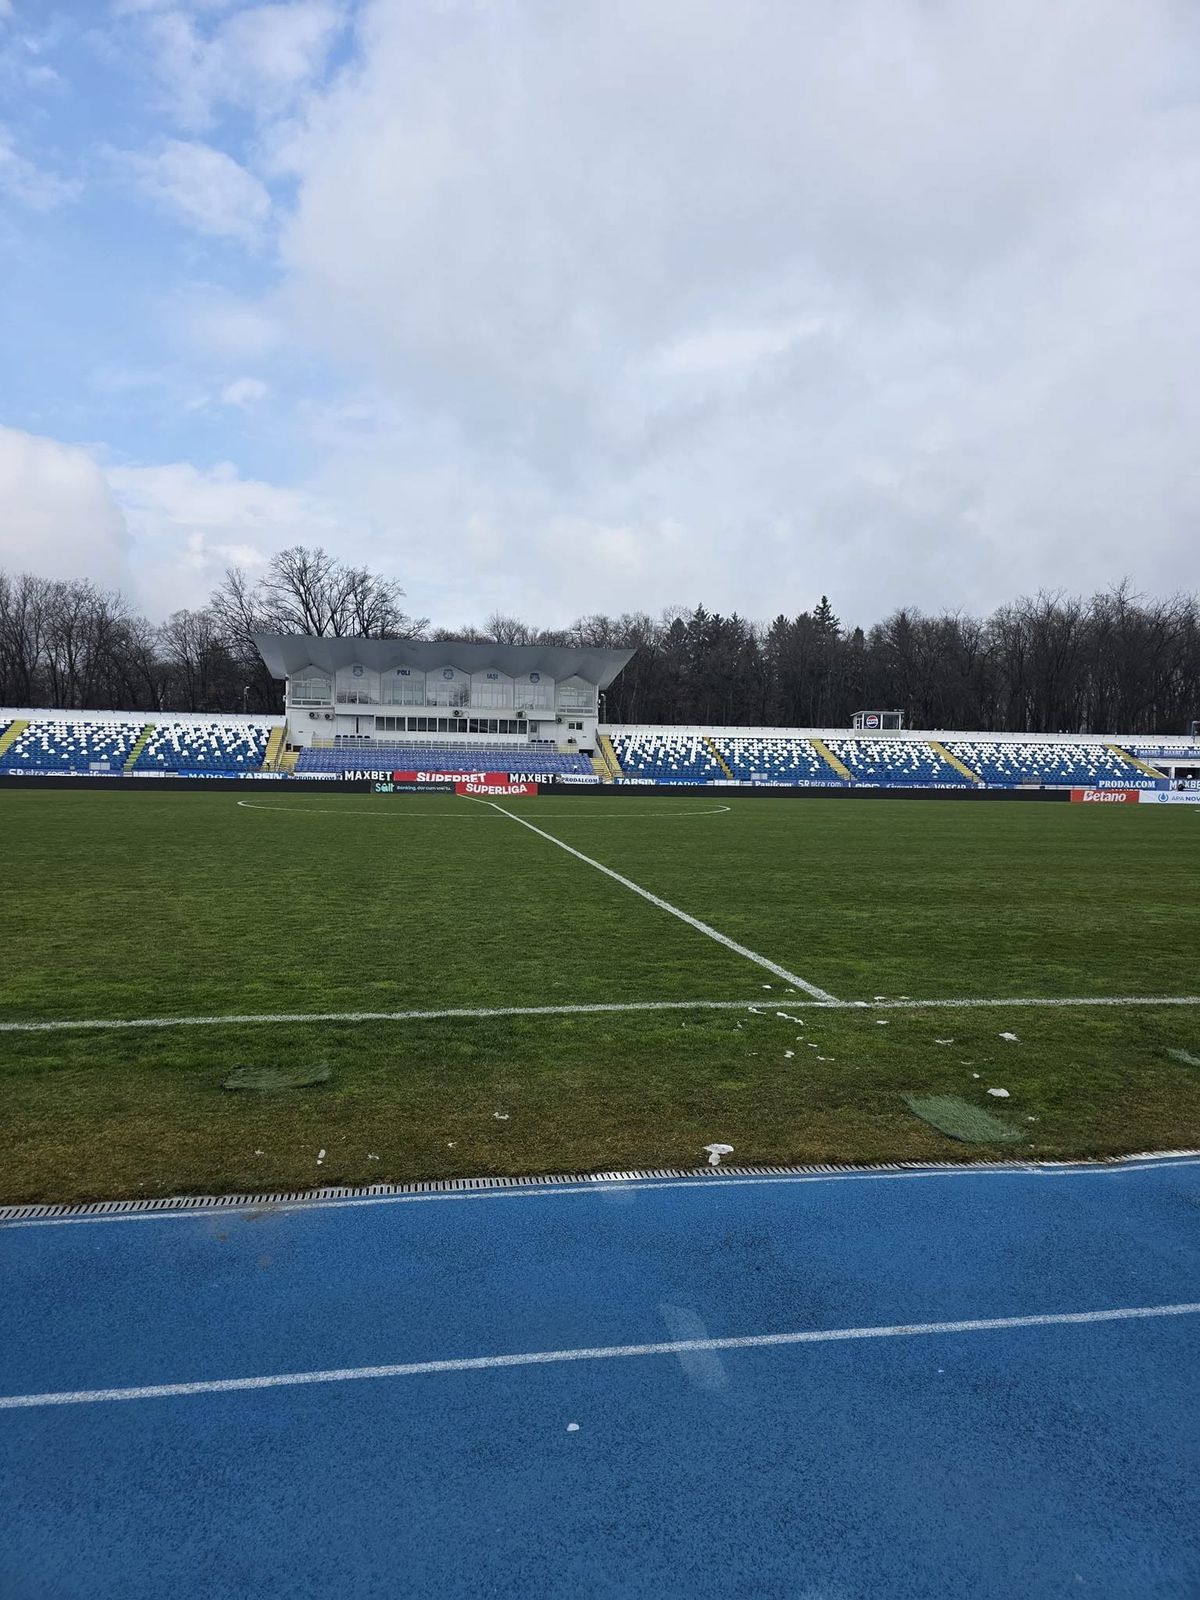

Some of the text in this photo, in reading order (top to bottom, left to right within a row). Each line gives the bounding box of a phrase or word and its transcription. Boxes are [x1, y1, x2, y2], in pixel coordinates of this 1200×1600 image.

[345, 770, 392, 781] MAXBET
[510, 773, 553, 783] MAXBET
[466, 784, 527, 794] SUPERLIGA
[1098, 780, 1156, 788] PRODALCOM
[1083, 790, 1127, 802] Betano
